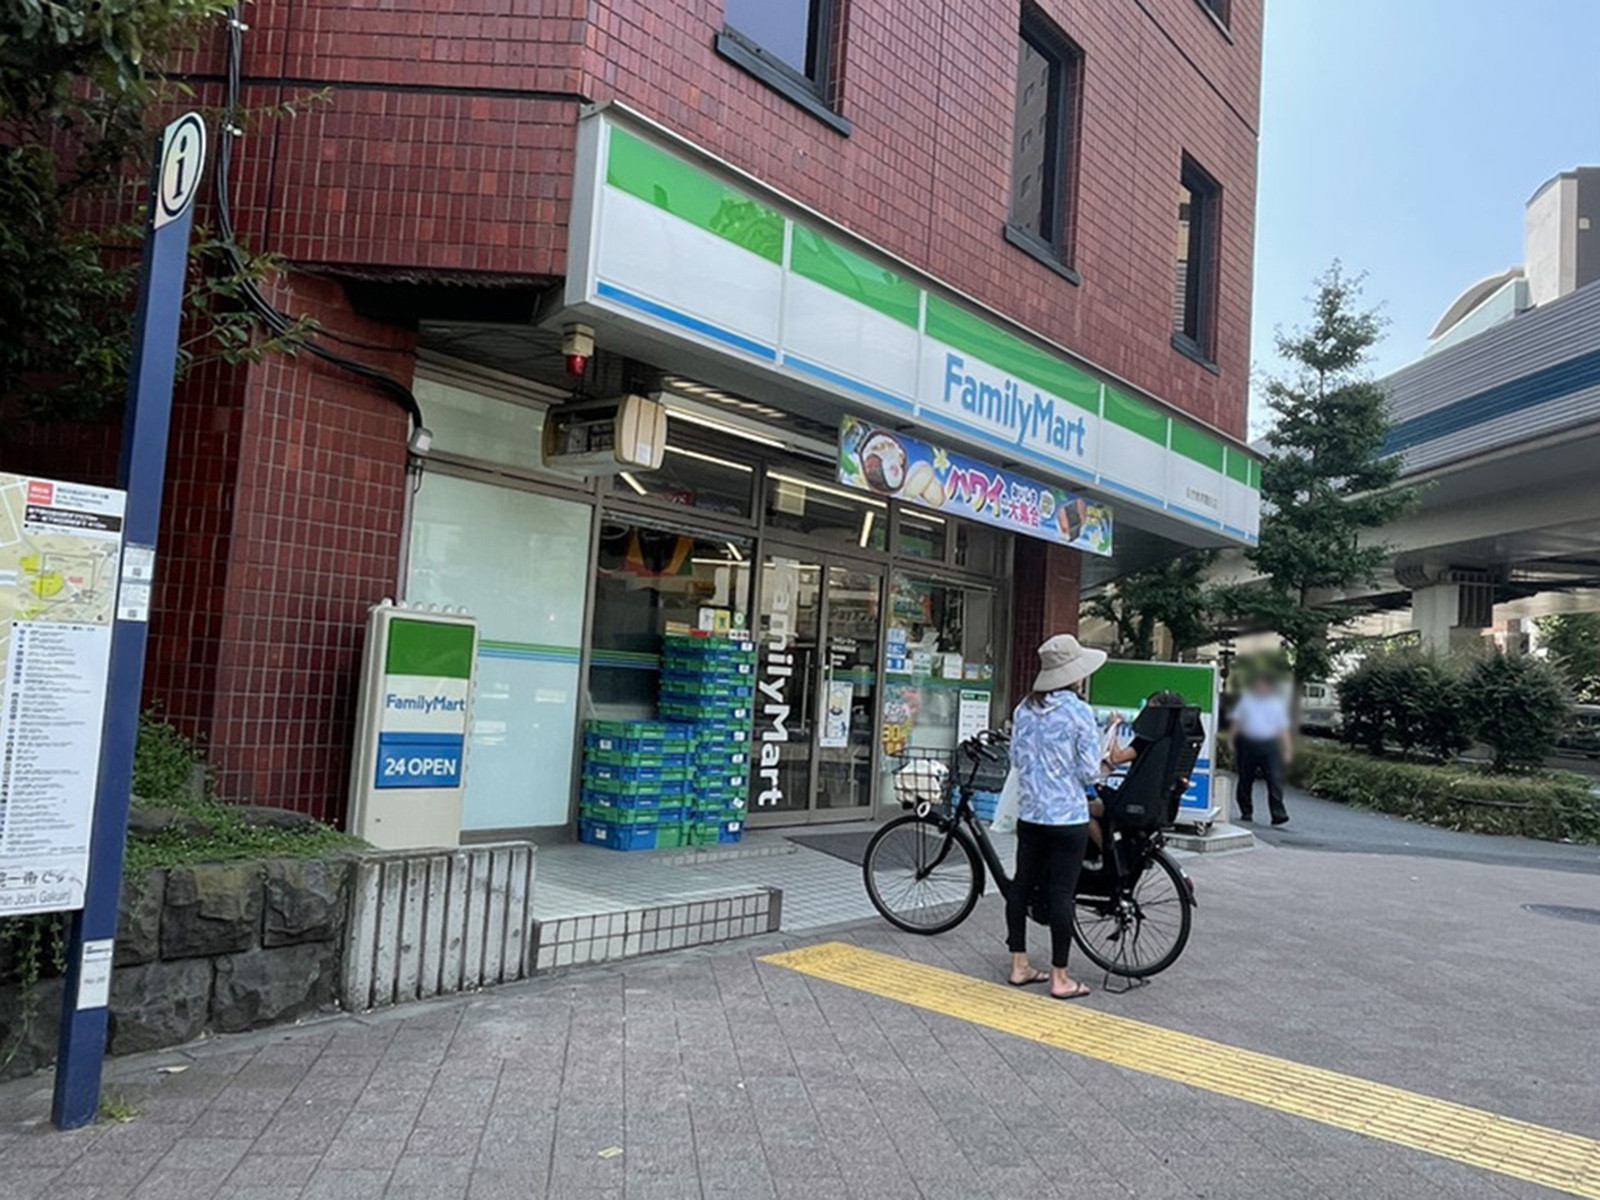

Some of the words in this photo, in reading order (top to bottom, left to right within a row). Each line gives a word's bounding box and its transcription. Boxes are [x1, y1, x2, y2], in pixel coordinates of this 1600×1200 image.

[943, 351, 1086, 456] FamilyMart
[385, 693, 465, 714] FamilyMart
[384, 757, 406, 776] 24
[407, 757, 457, 776] OPEN
